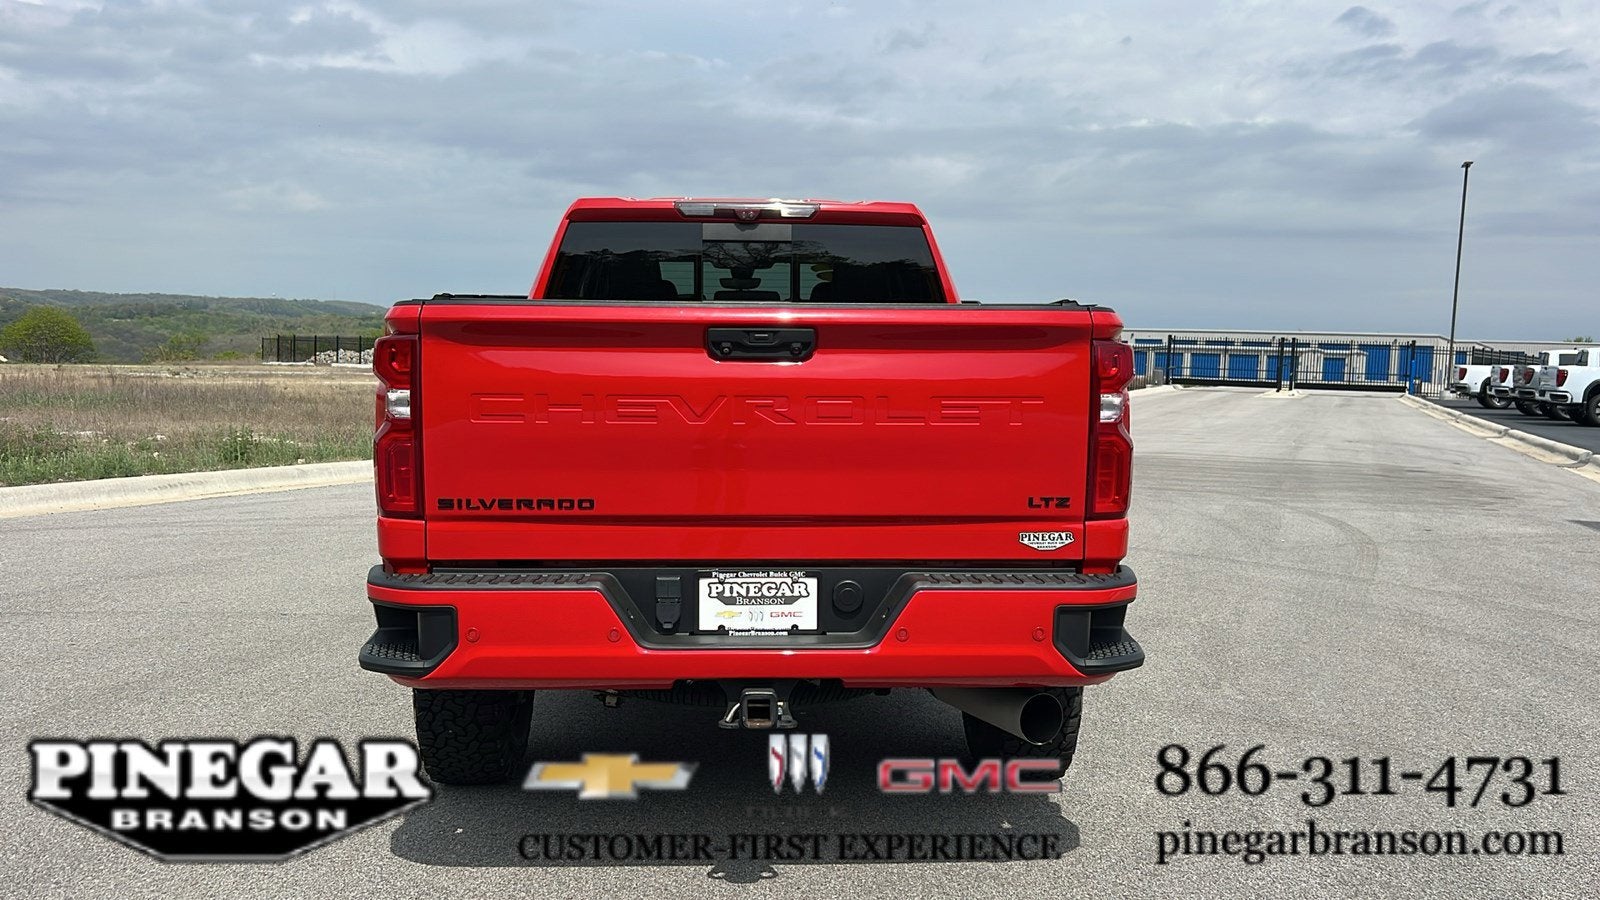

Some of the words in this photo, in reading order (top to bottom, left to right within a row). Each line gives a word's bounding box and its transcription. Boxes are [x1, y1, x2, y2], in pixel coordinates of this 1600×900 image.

[470, 392, 1044, 426] CHEVROLET
[437, 498, 595, 511] SILVERADO
[1028, 496, 1071, 509] LTZ
[1020, 533, 1074, 541] PINEGAR
[708, 582, 810, 598] PINEGAR
